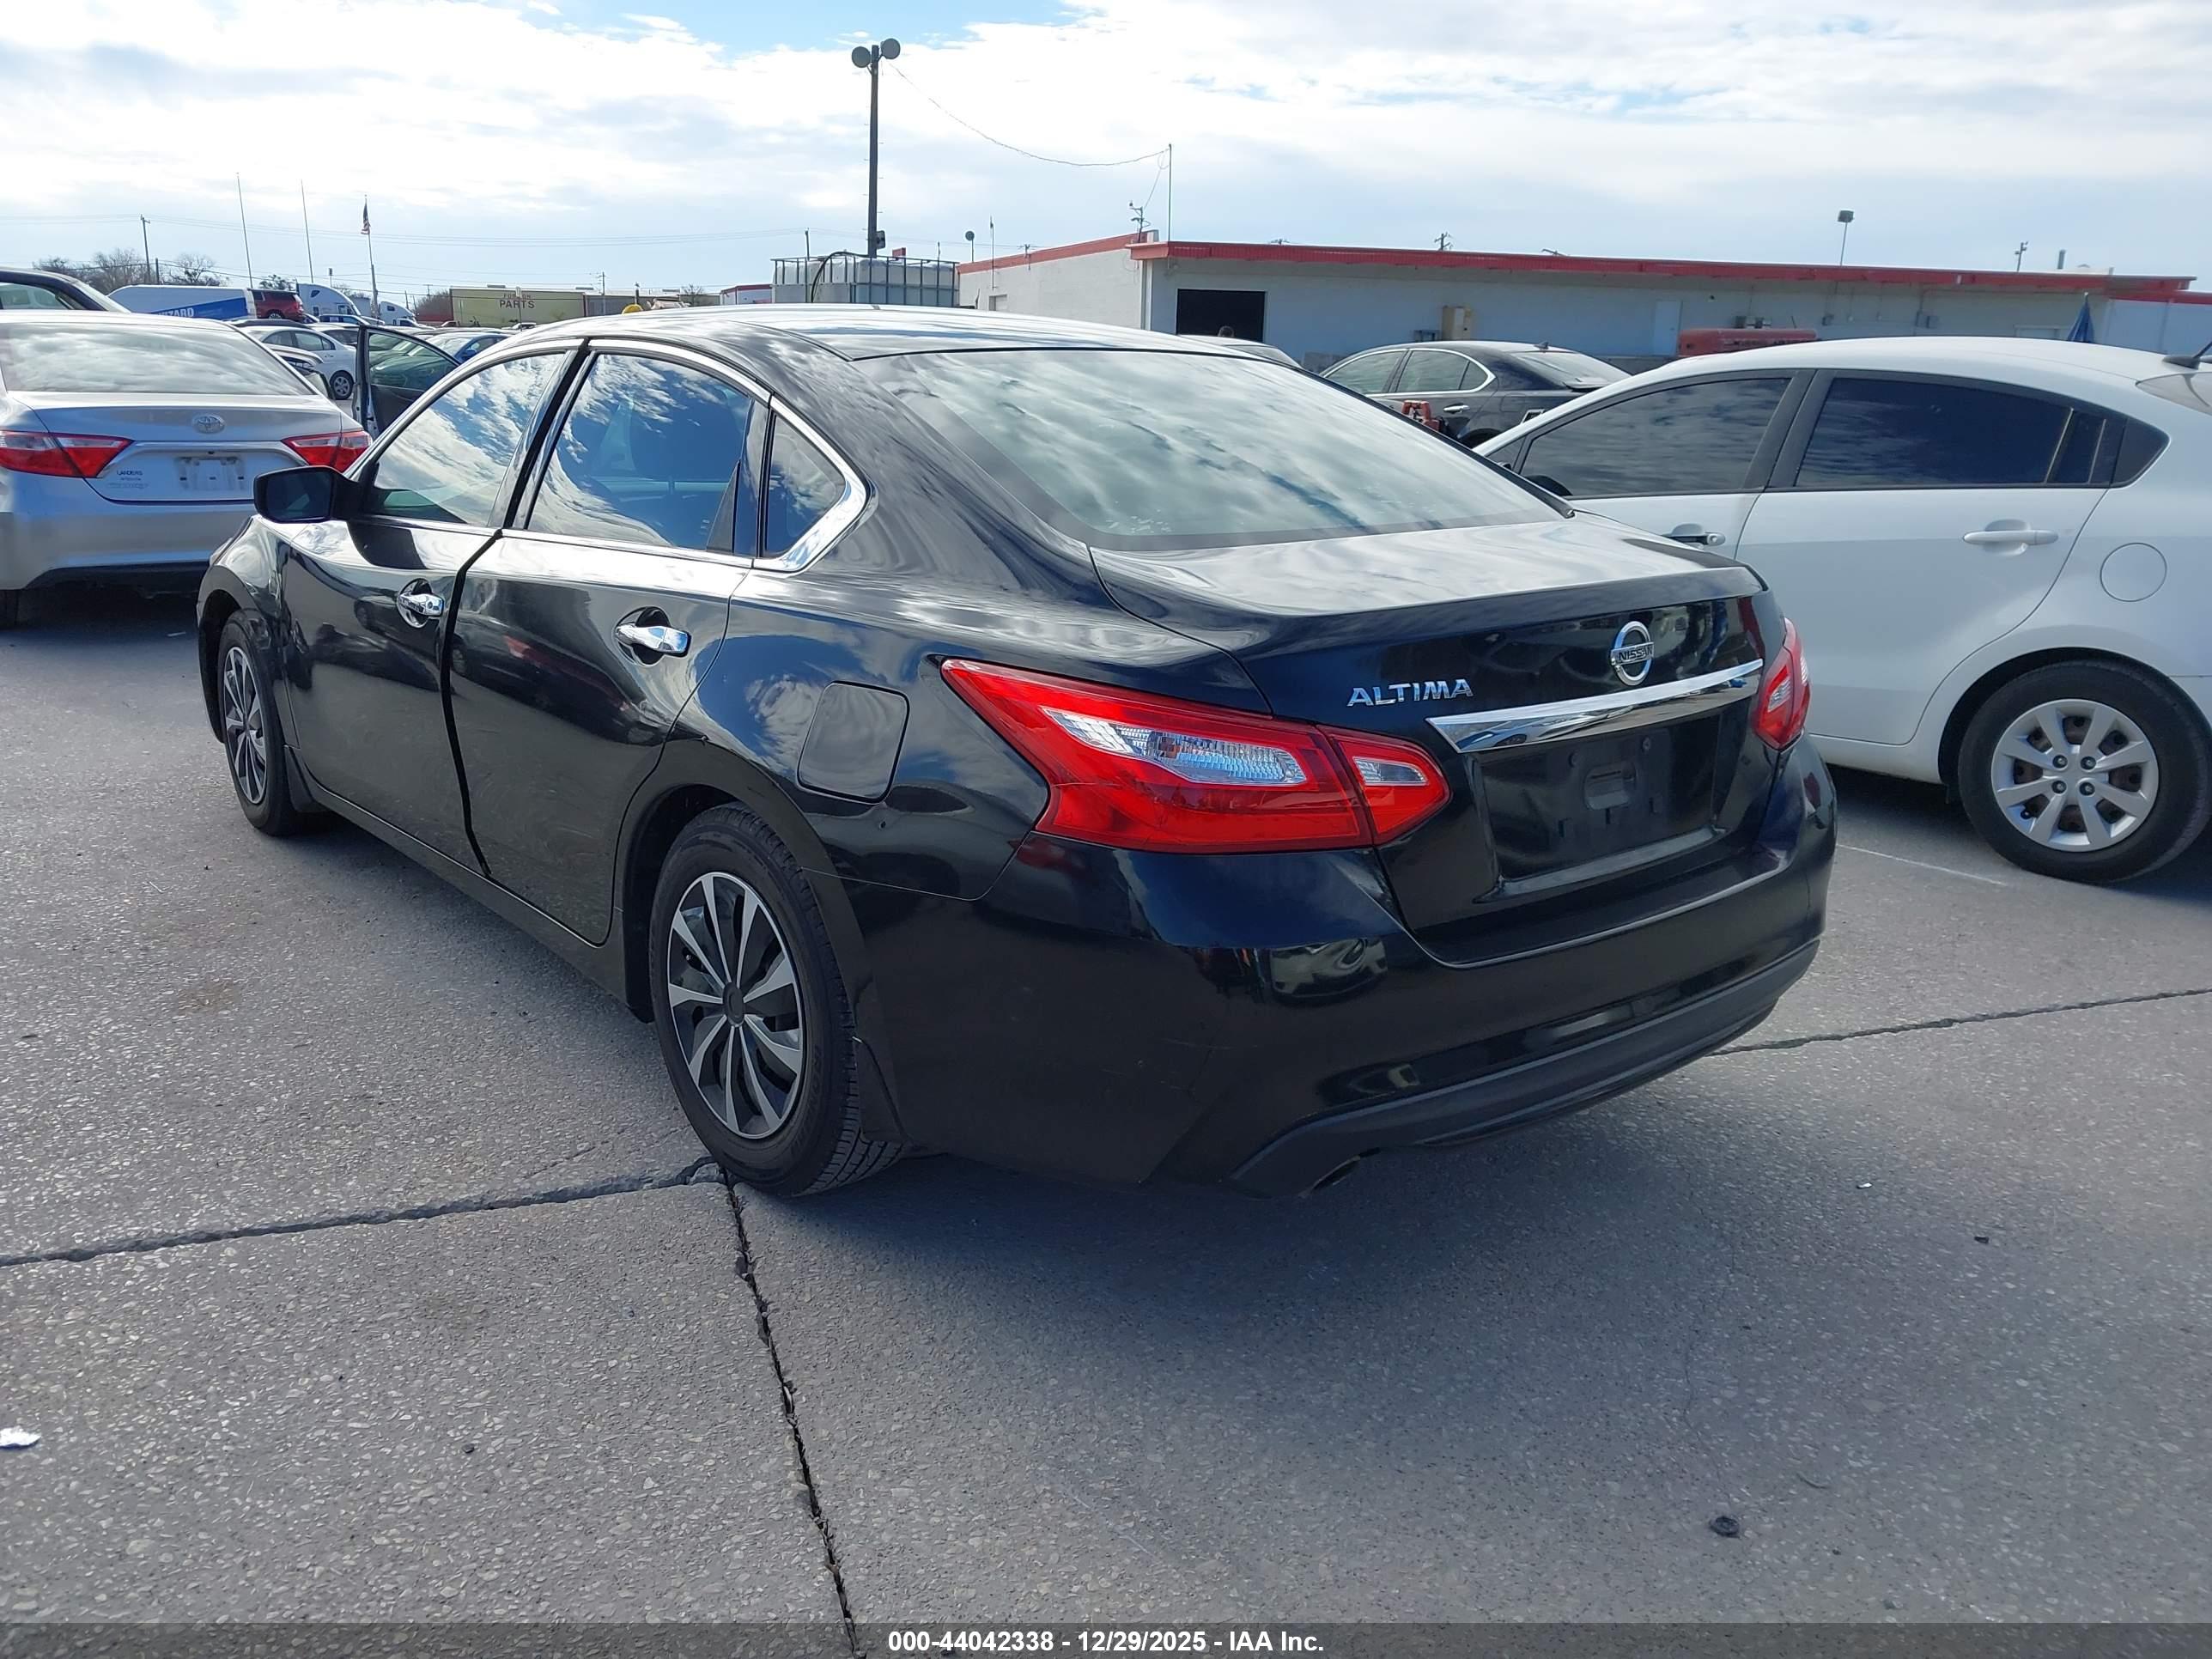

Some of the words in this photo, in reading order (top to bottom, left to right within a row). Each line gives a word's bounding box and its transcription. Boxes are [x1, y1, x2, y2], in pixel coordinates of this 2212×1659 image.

[500, 299, 535, 308] PARTS
[1616, 644, 1655, 662] NISSAN
[1346, 678, 1474, 707] ALTIMA
